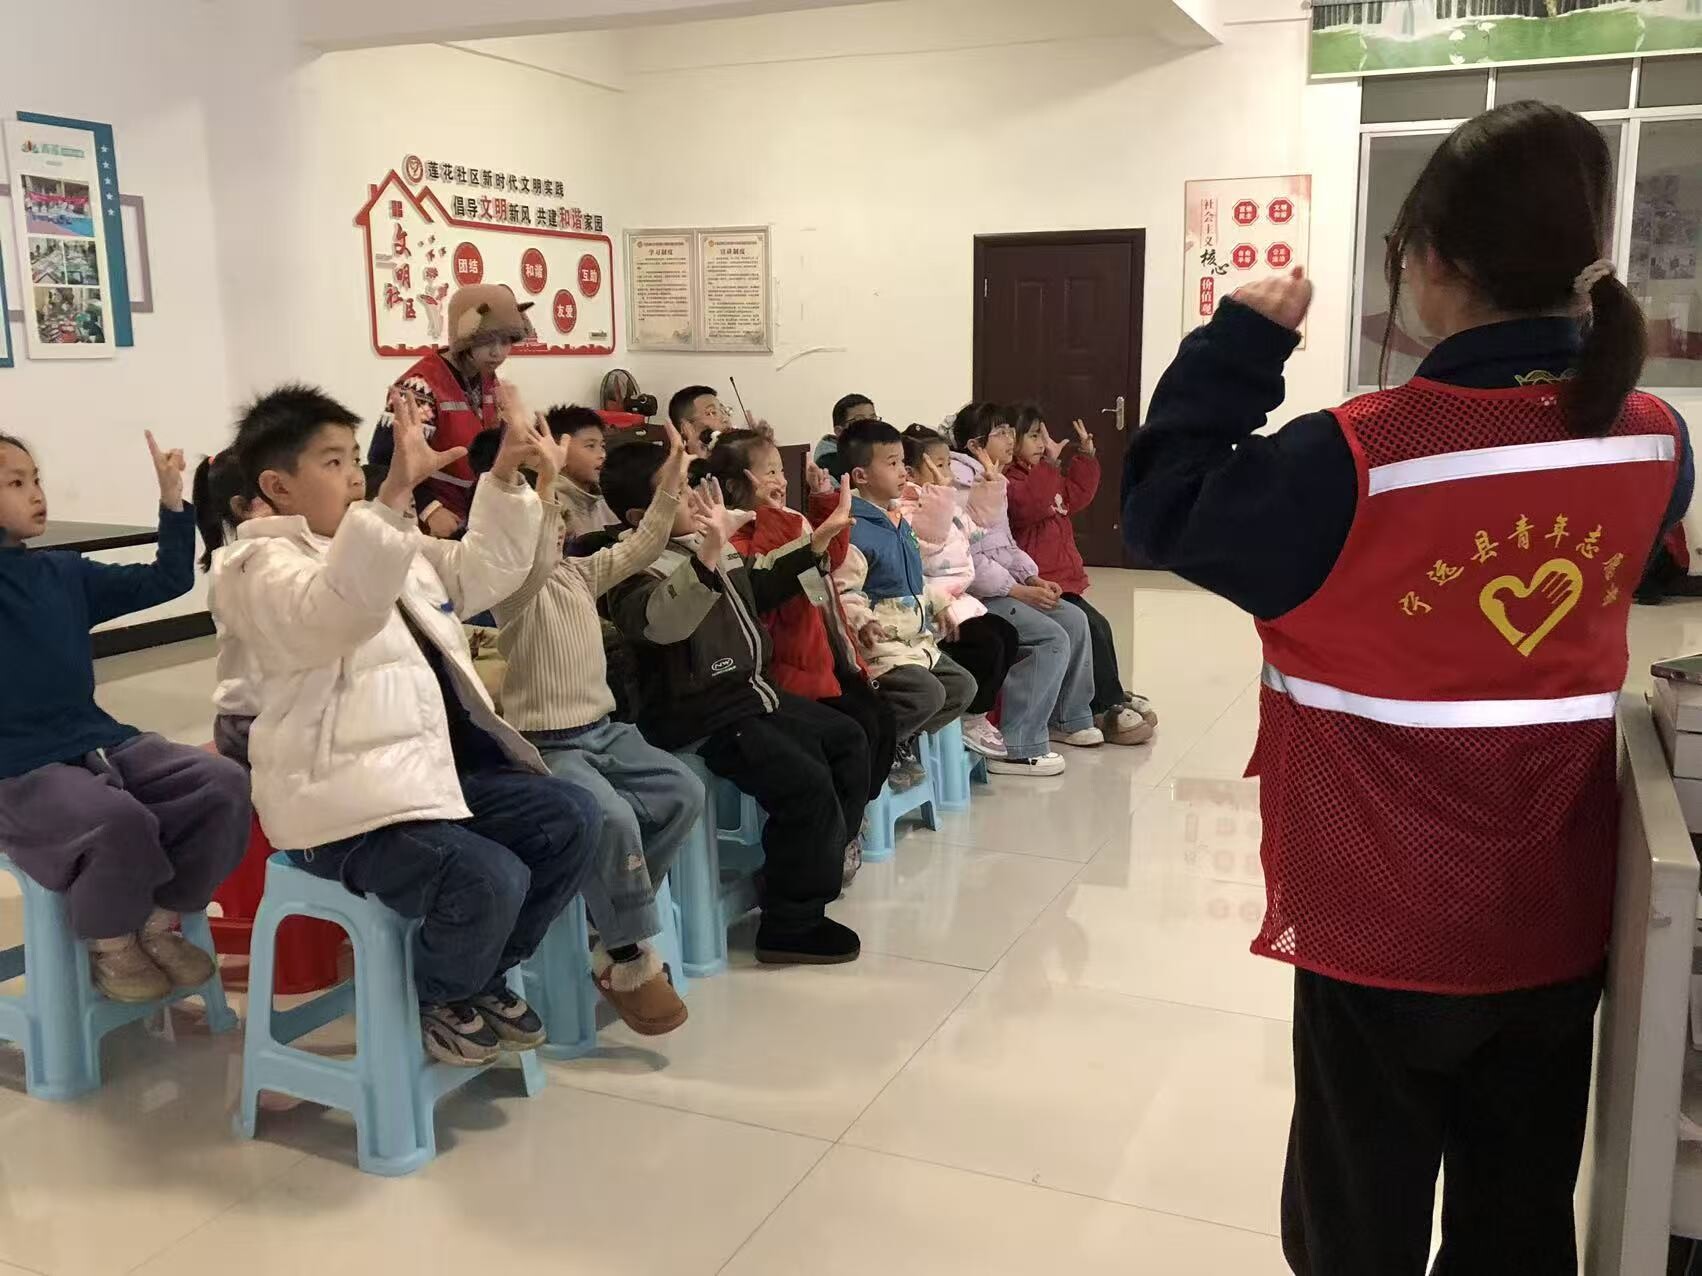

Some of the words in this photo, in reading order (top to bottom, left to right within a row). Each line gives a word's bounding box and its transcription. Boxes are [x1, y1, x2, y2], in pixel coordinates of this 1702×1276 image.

[427, 161, 564, 197] 莲花社区新时代文明实践
[453, 195, 531, 225] 倡导文明新风
[536, 206, 603, 232] 共建和谐家园
[1203, 199, 1214, 247] 社会主义
[458, 258, 479, 275] 团结
[525, 263, 544, 279] 和谐
[1200, 248, 1230, 276] 核心
[581, 268, 598, 284] 互助
[556, 304, 573, 318] 友爱
